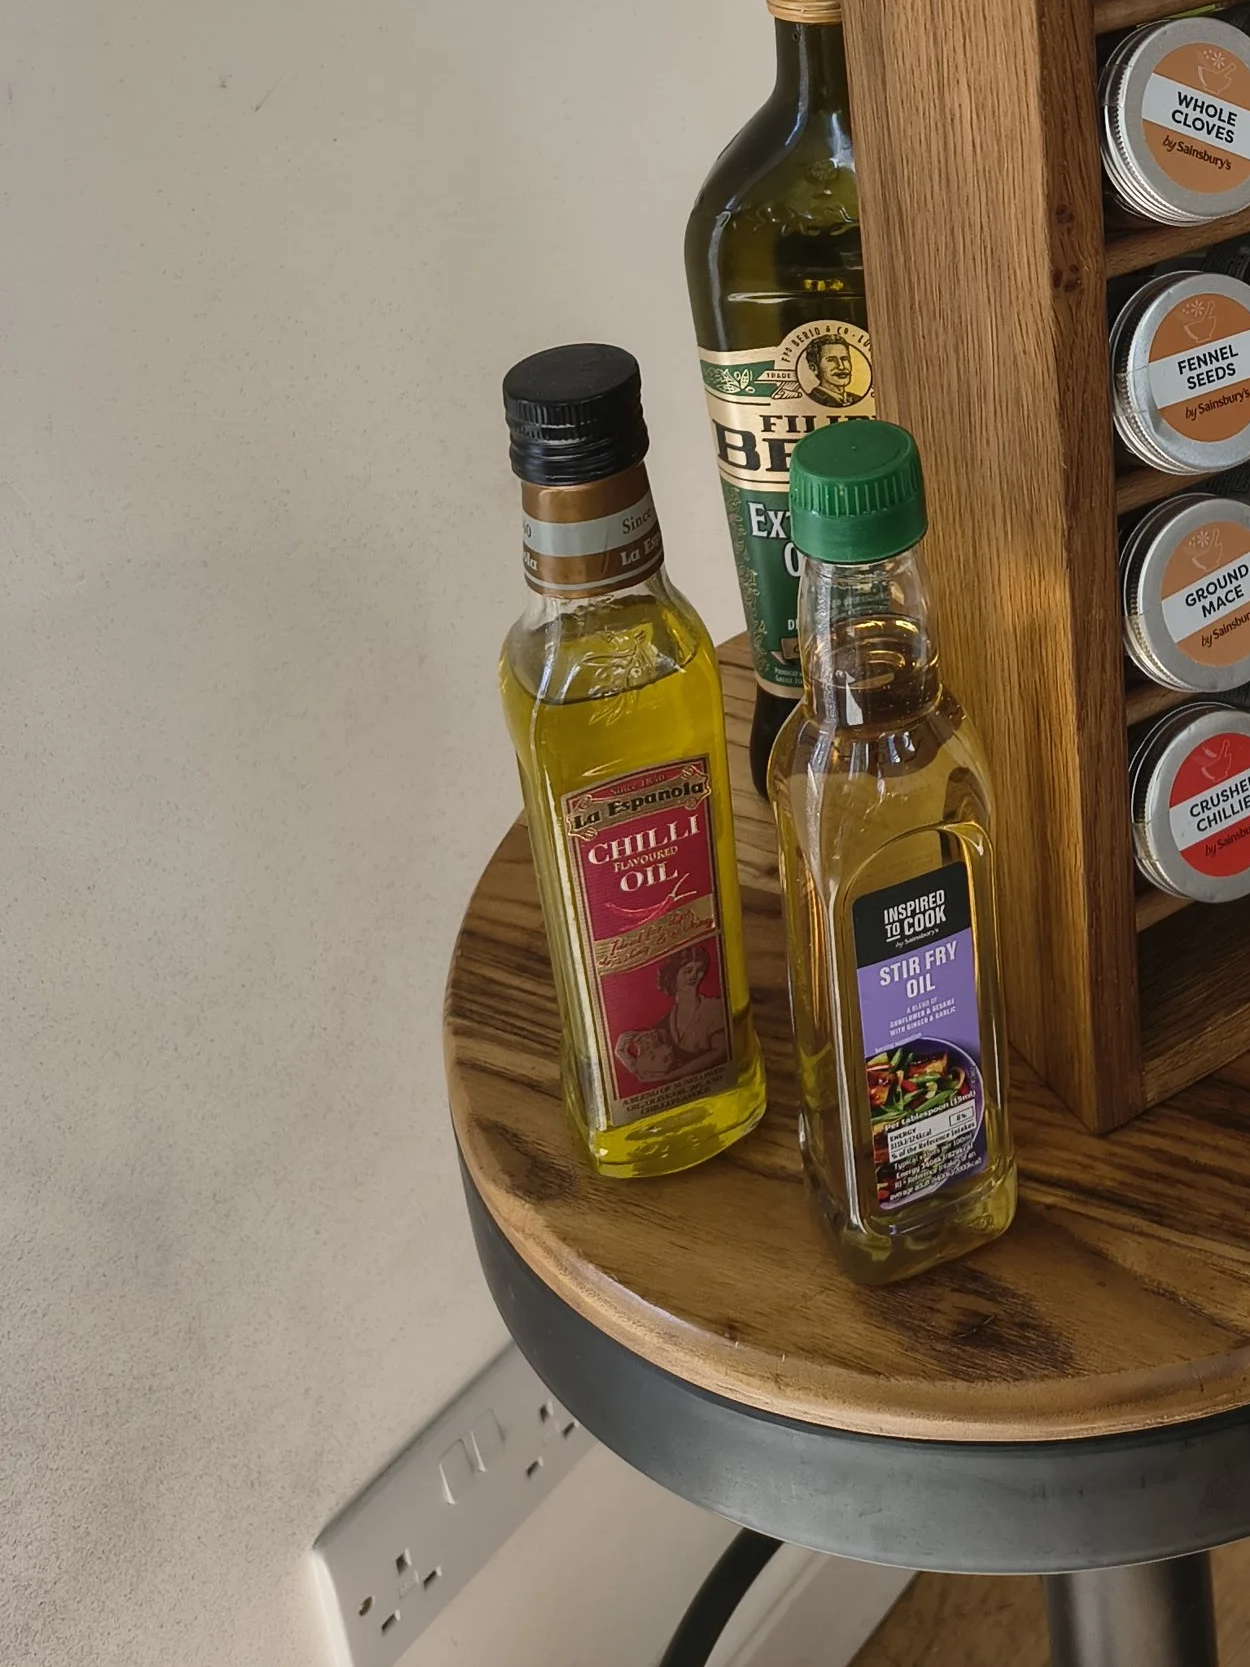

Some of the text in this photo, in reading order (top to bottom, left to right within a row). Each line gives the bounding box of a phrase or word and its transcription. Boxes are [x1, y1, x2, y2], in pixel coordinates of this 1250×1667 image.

[1177, 91, 1238, 127] WHOLE
[1171, 110, 1235, 144] CLOVES
[1162, 135, 1232, 171] by Sainsbury's
[1177, 344, 1238, 375] FENNEL
[1187, 363, 1237, 390] SEEDS
[1185, 387, 1250, 420] by Sainsbury's
[1185, 564, 1249, 608] GROUND
[1201, 585, 1245, 618] MACE
[1201, 632, 1213, 647] by
[574, 811, 600, 829] La
[588, 814, 699, 865] CHILLI
[1204, 842, 1217, 857] by
[614, 846, 678, 873] FLAVOURED
[620, 862, 678, 892] OIL
[884, 890, 945, 924] INSPIRED
[885, 905, 946, 938] TO COOK
[879, 940, 957, 986] STIR FRY
[906, 974, 935, 998] OIL
[885, 1122, 899, 1131] Per
[901, 1103, 949, 1125] tablespoon
